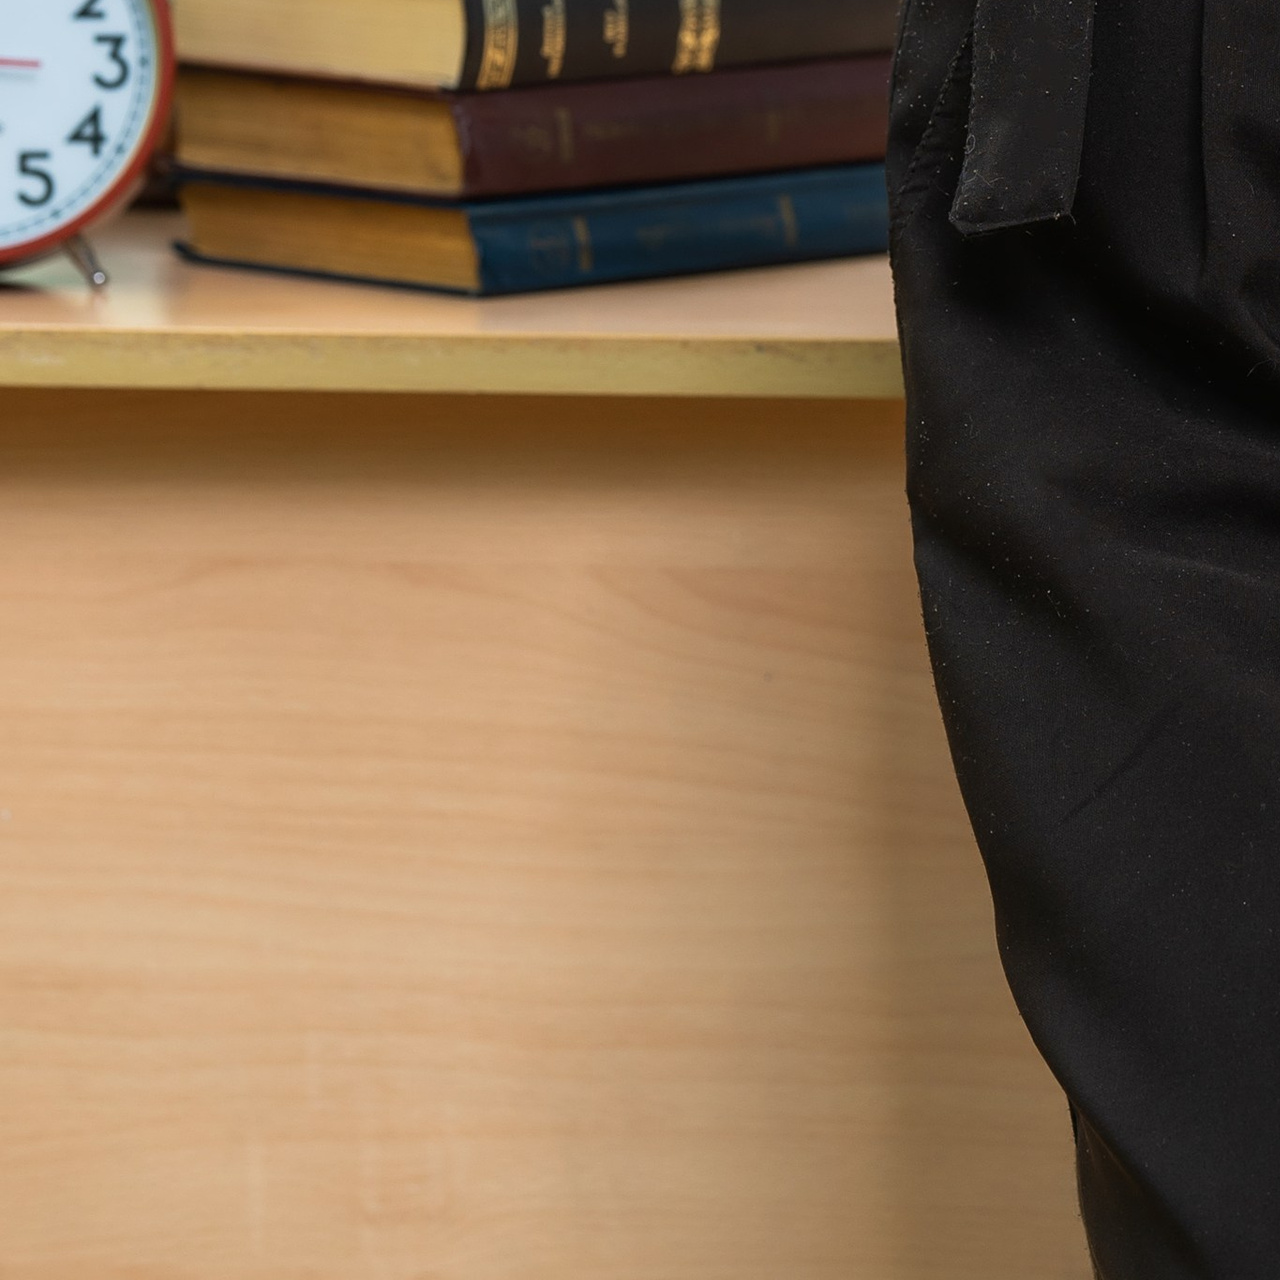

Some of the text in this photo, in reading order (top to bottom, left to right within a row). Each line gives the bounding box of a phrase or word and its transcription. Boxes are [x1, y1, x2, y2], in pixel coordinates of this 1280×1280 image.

[93, 34, 130, 90] 3
[67, 106, 106, 157] 4
[17, 151, 55, 207] 5
